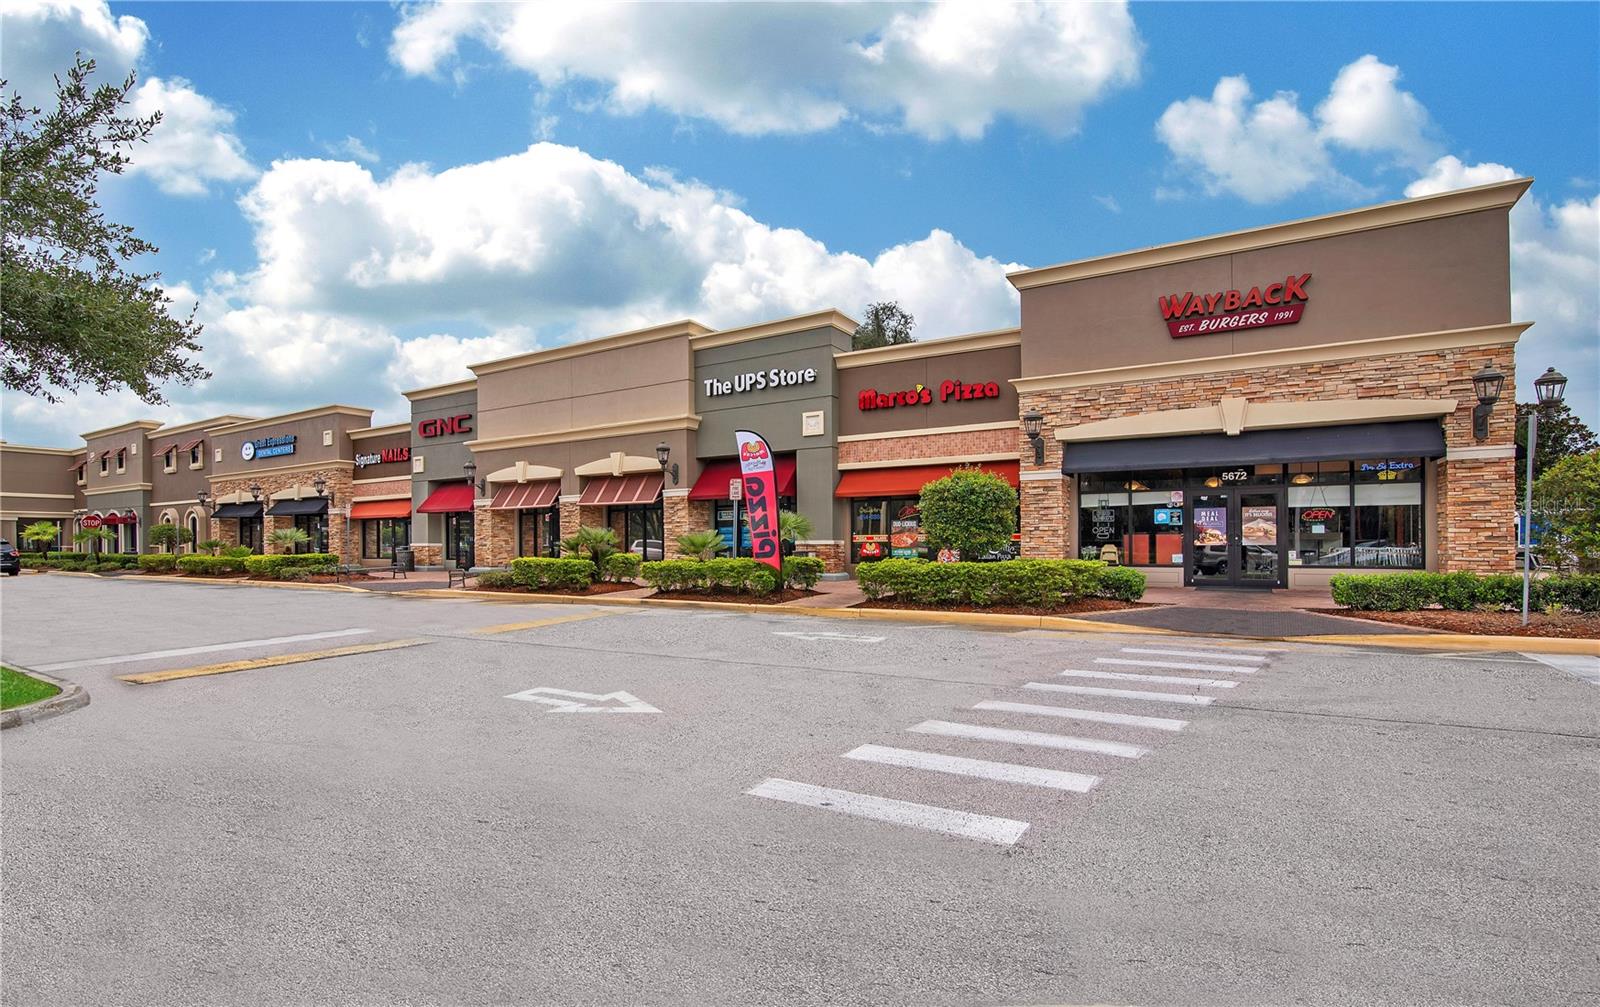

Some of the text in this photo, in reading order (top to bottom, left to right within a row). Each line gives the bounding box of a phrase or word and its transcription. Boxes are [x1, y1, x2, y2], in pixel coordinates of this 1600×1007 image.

[1158, 273, 1312, 321] WAYBACK
[1178, 310, 1294, 333] EST. BURGERS 1991
[704, 366, 817, 398] The UPS Store
[858, 378, 1000, 411] Marco's Pizza
[418, 414, 473, 438] GNC
[355, 447, 409, 468] Signature NAILS
[1222, 471, 1248, 481] 5672
[82, 519, 102, 527] STOP
[1304, 511, 1333, 519] OPEN
